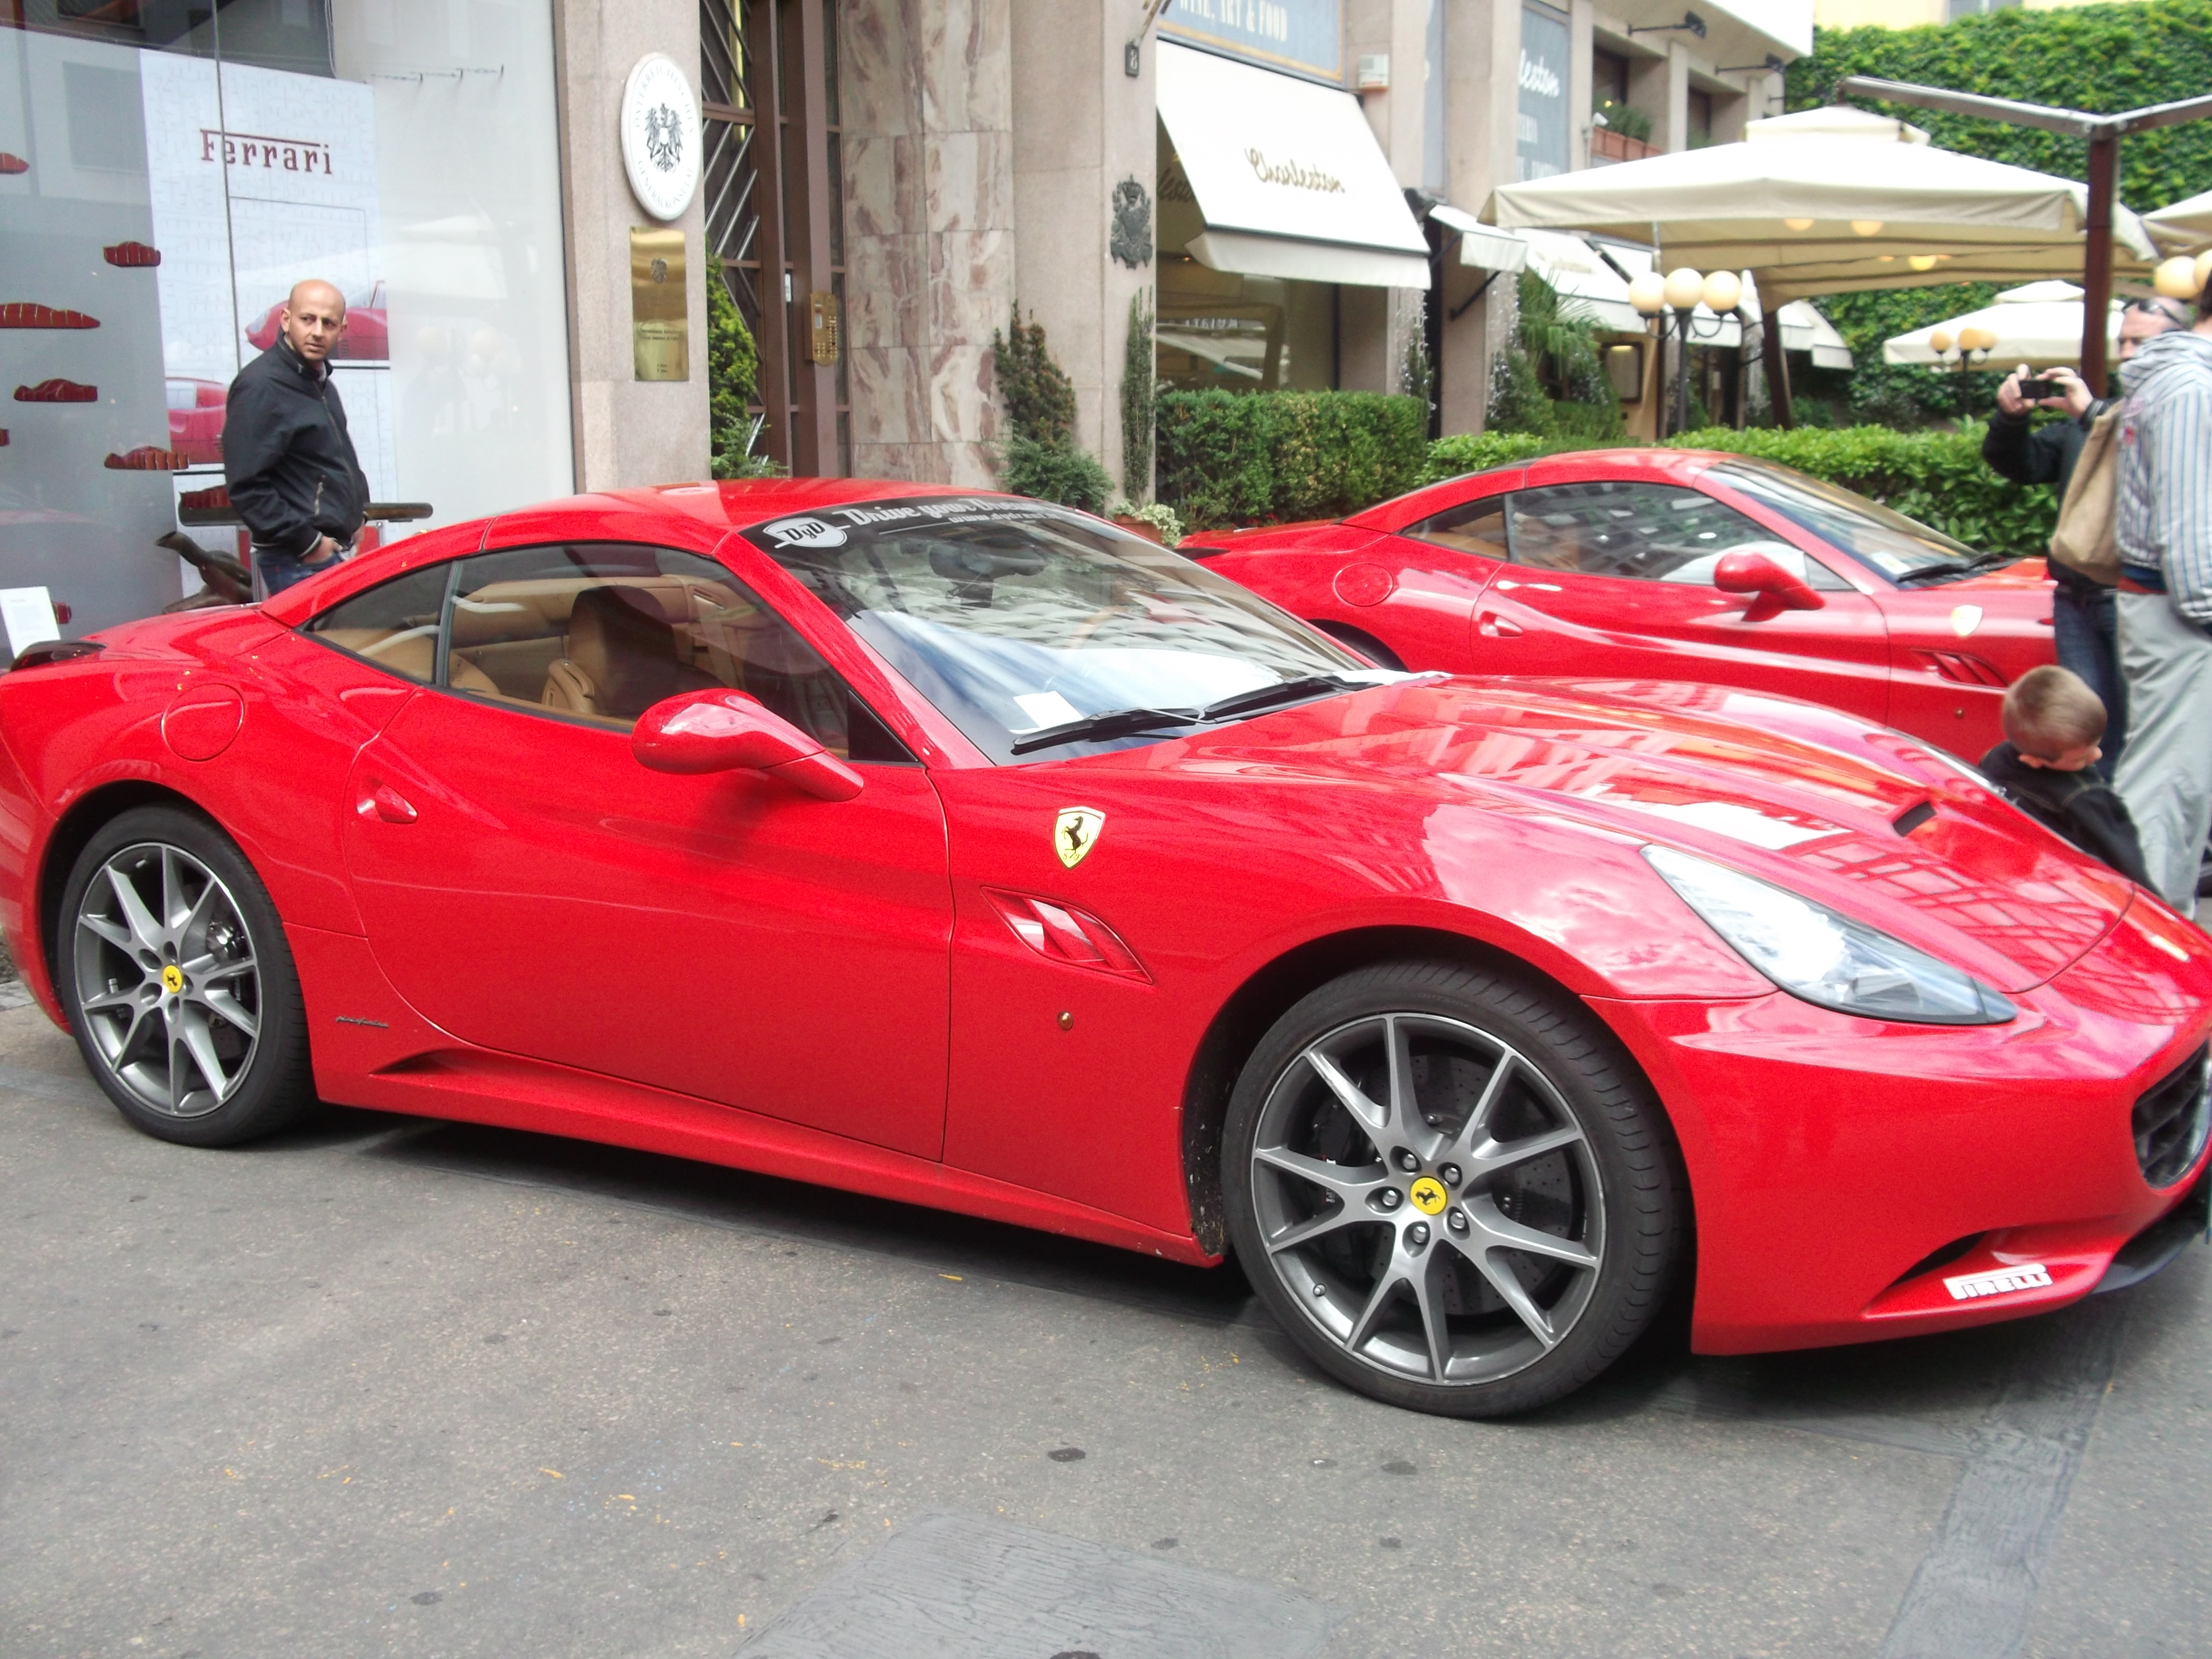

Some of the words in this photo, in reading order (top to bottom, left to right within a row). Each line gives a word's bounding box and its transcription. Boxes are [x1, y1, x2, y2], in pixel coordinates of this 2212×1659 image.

[200, 128, 332, 174] Ferrari
[1244, 148, 1345, 193] Charleston
[776, 522, 825, 541] DyD
[832, 506, 921, 525] Drive
[917, 502, 977, 519] your
[1942, 1263, 2054, 1300] PIRELLI
